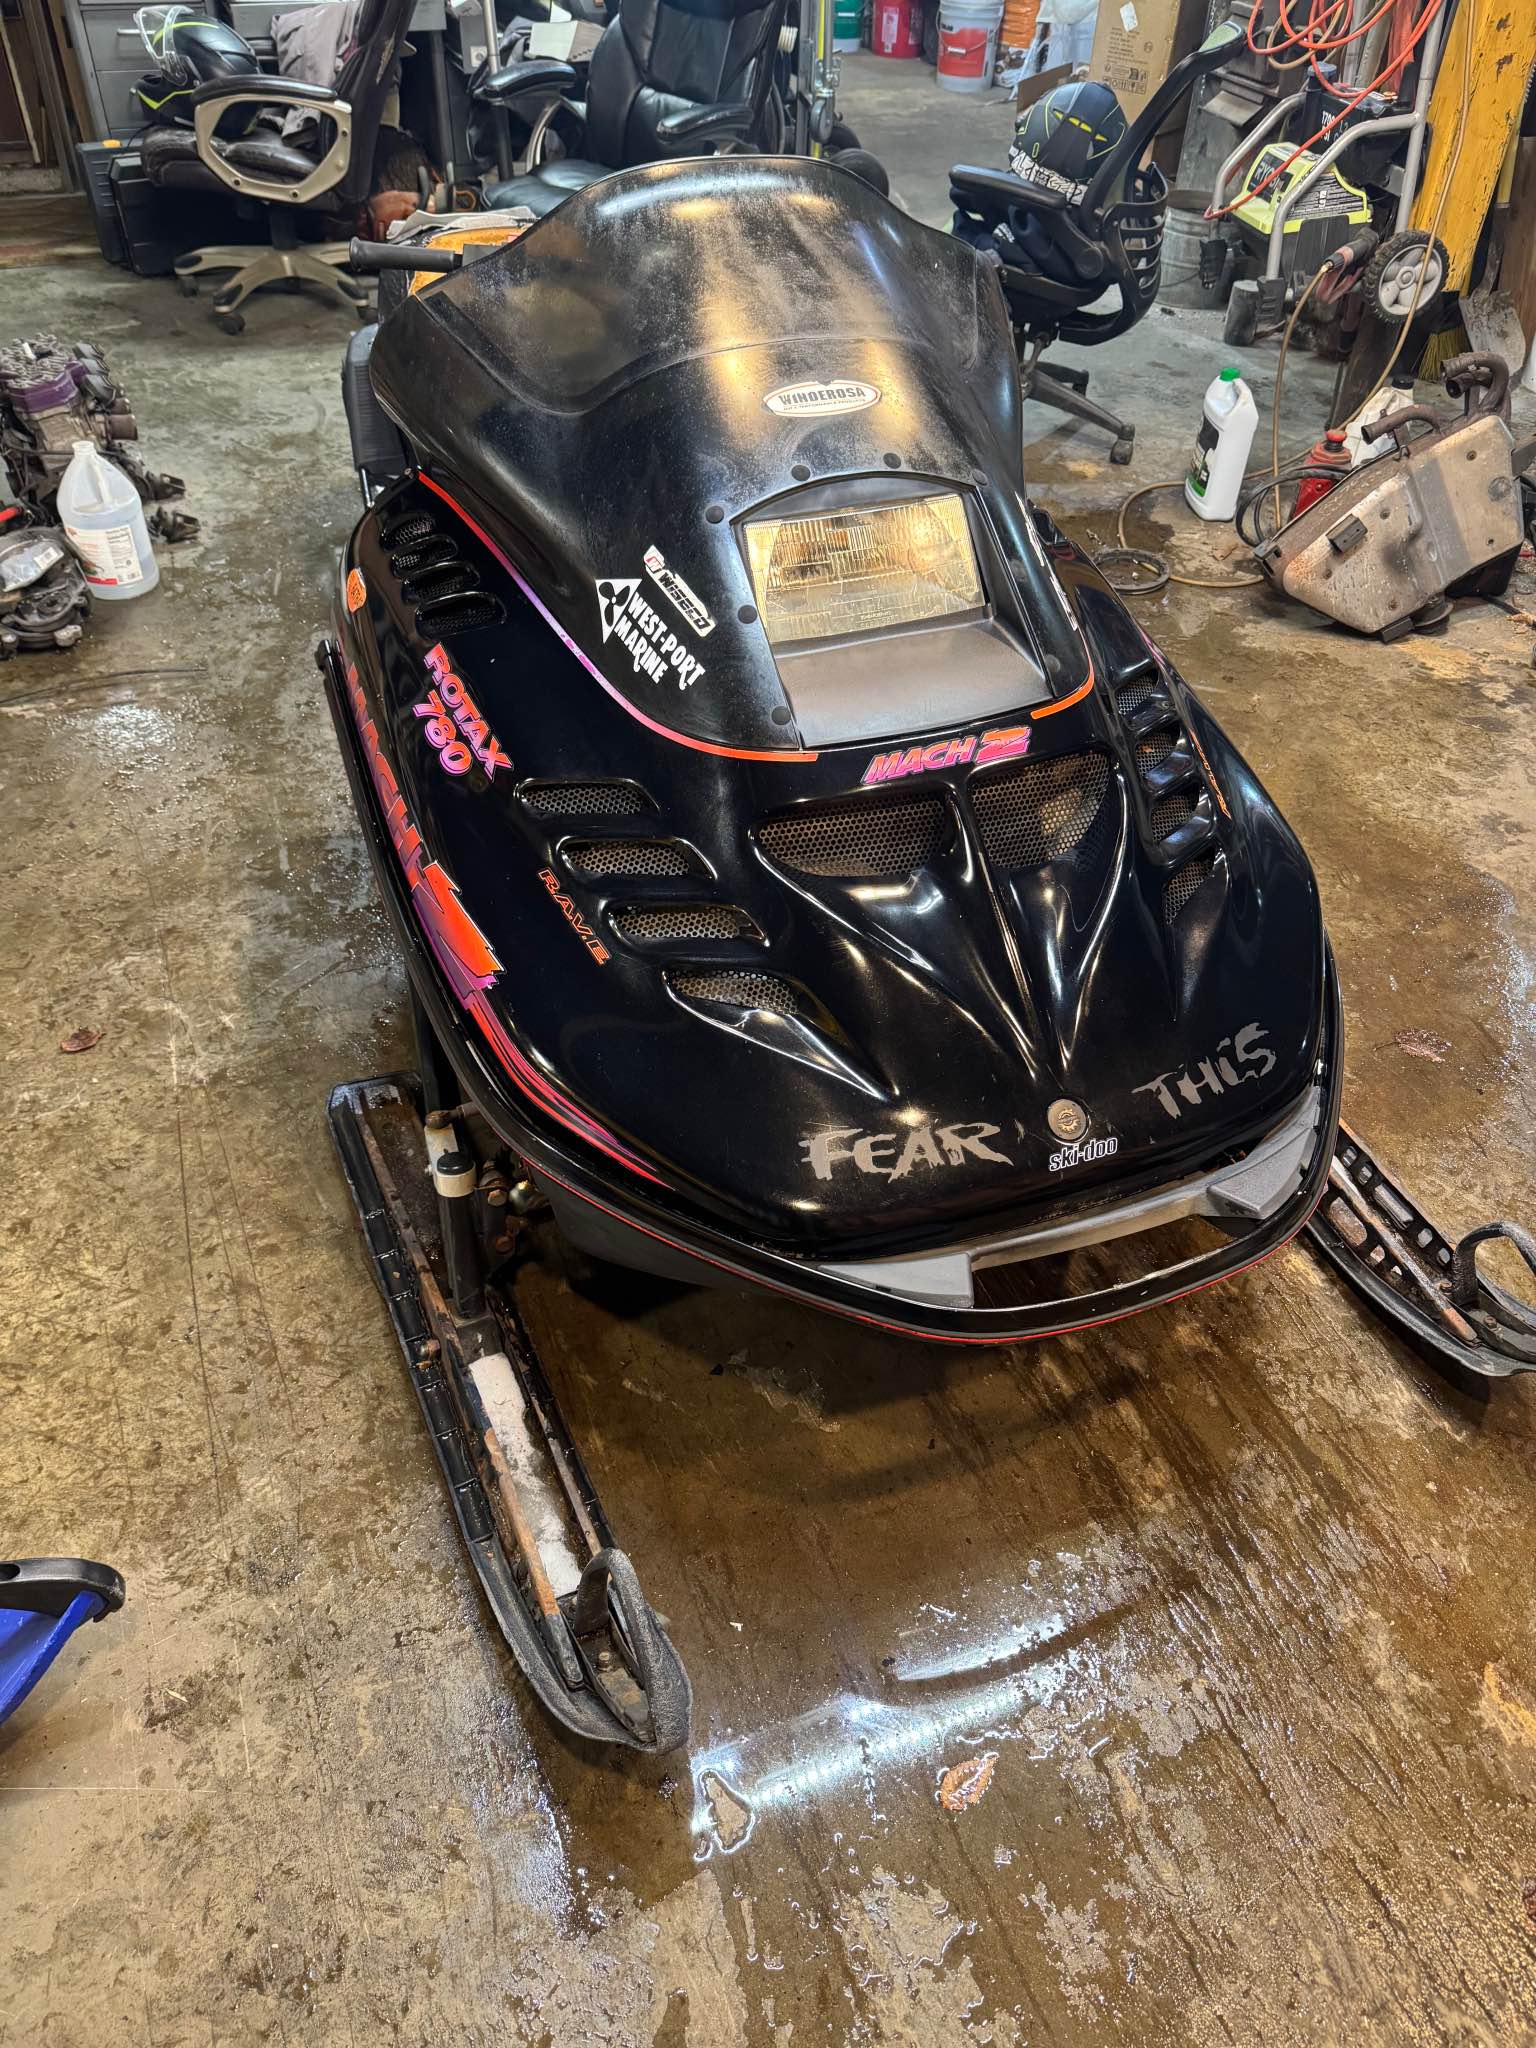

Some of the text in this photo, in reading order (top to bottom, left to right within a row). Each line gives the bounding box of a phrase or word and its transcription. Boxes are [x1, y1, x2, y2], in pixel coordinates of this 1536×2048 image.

[778, 387, 866, 406] WINDEROSA
[594, 614, 669, 684] MARINE
[628, 591, 706, 691] WEST-PORT
[412, 689, 473, 777] 780
[423, 641, 515, 783] ROTAX
[861, 736, 977, 785] MACH
[798, 1120, 1014, 1183] FEAR
